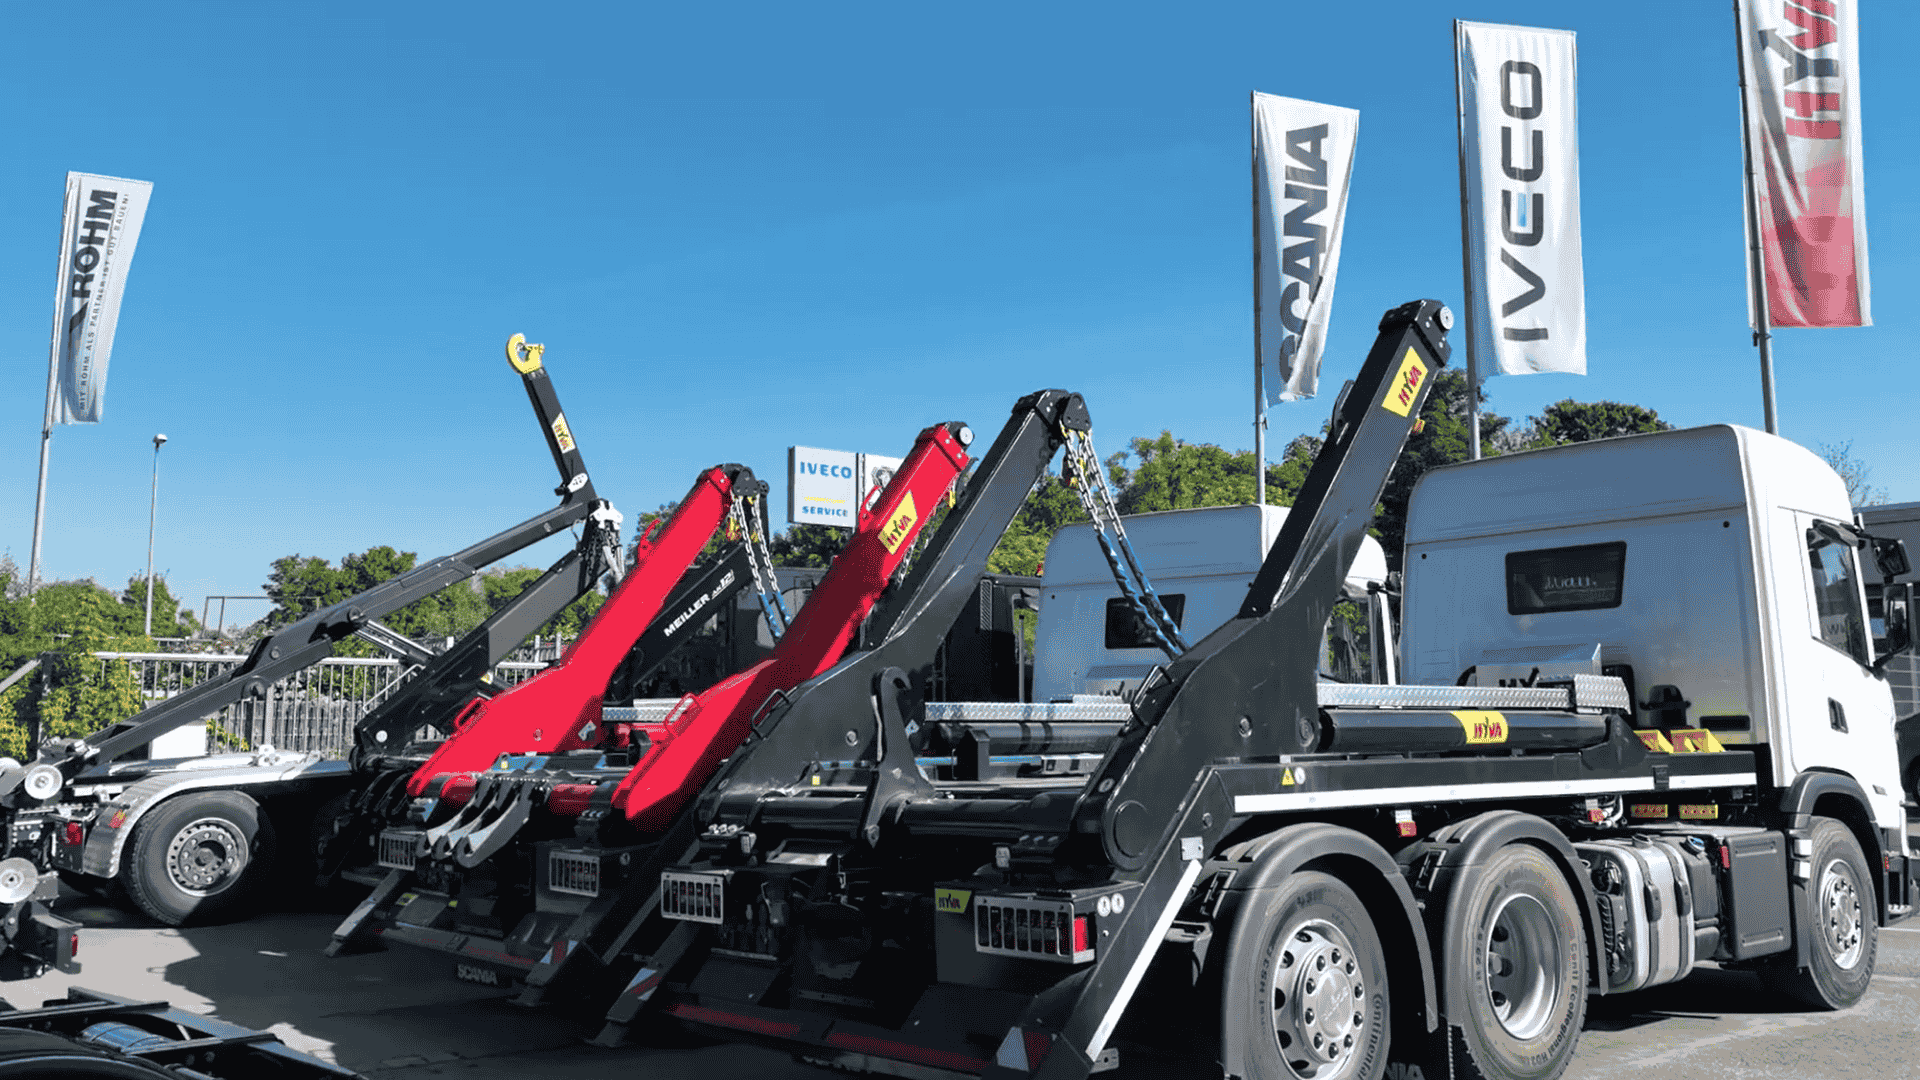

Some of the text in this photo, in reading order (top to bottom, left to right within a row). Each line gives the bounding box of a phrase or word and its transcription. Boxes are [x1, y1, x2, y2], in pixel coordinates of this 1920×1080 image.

[1500, 60, 1549, 342] IVECO
[72, 189, 118, 298] ROHM
[107, 235, 118, 256] GUT
[90, 281, 106, 327] PARTNER
[86, 332, 95, 351] ALS
[1398, 365, 1423, 407] HYVA
[554, 423, 570, 451] HYVA
[800, 461, 853, 479] IVECO
[801, 505, 849, 518] SERVICE
[886, 514, 913, 547] HYVA
[663, 593, 711, 637] MEILLER
[1474, 715, 1503, 739] HYVA
[938, 893, 961, 909] HYVA
[457, 964, 498, 986] SCANIA
